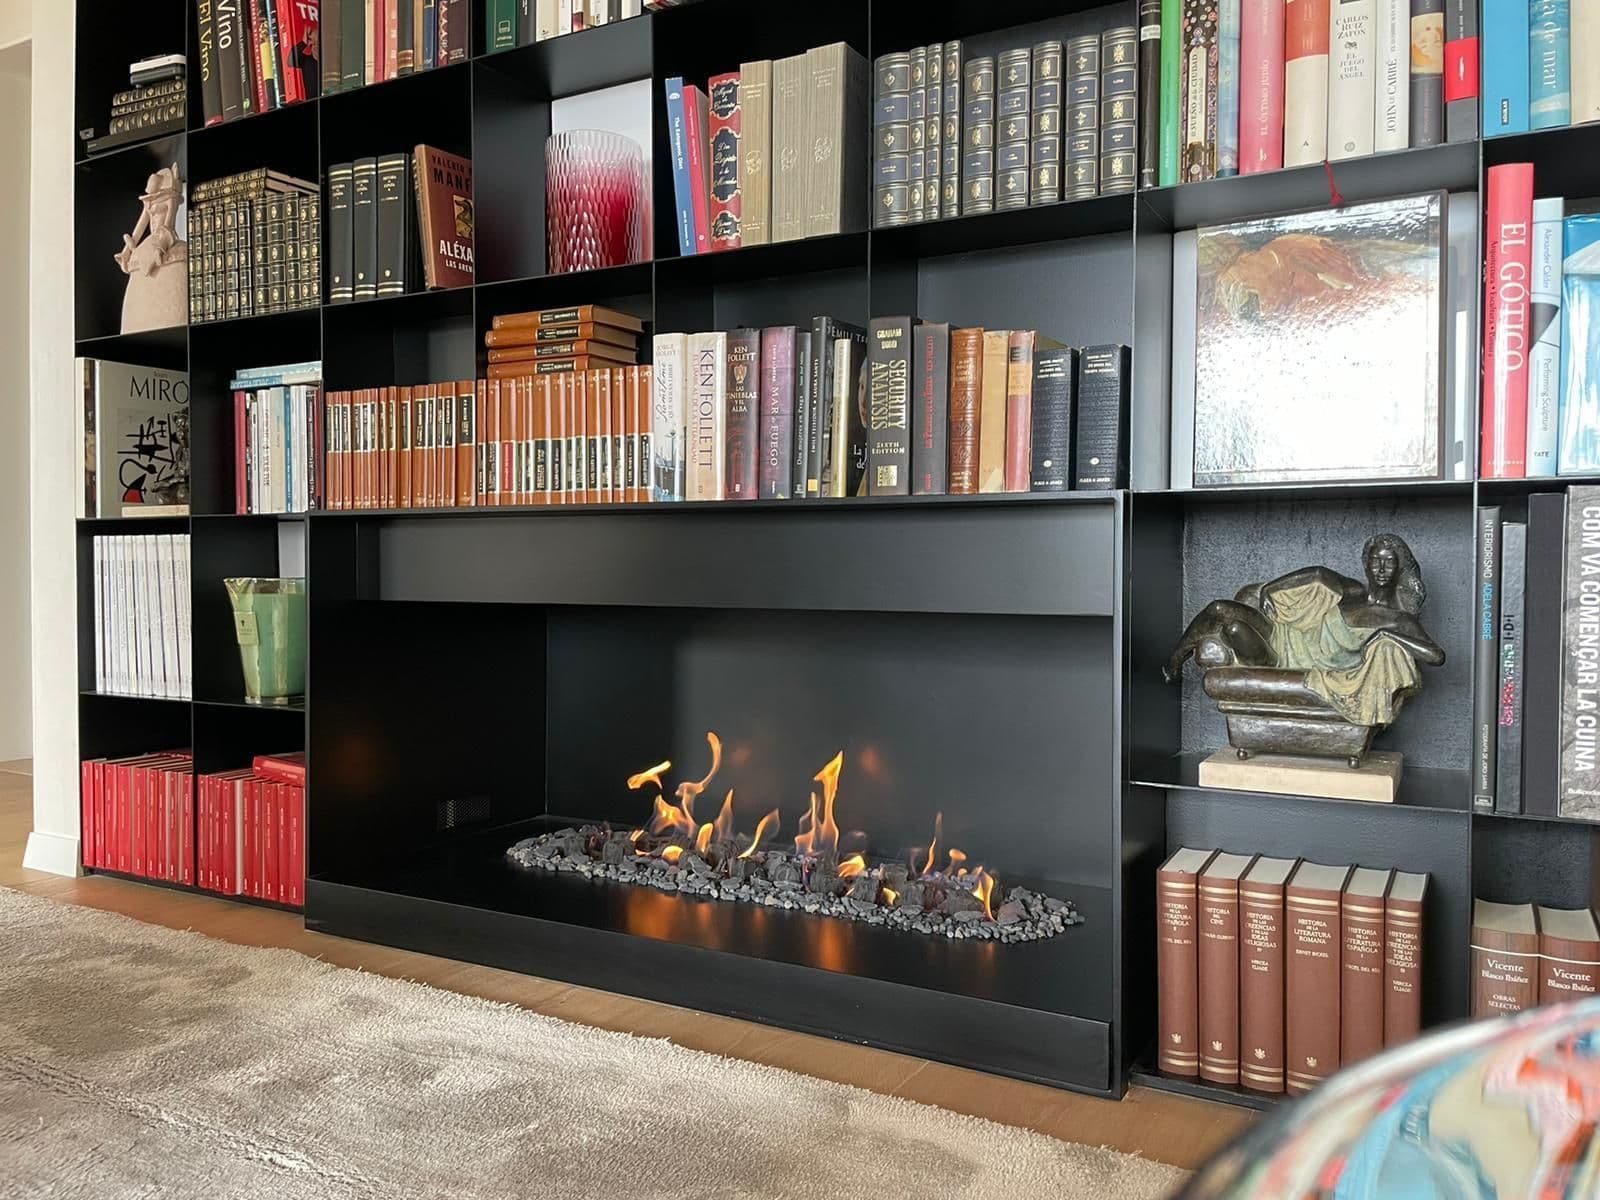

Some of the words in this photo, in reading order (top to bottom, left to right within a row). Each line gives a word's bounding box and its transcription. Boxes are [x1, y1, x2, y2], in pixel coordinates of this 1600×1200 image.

[217, 0, 236, 49] Vino
[1335, 15, 1369, 26] CARLOS
[1341, 23, 1364, 32] RUIZ
[1543, 22, 1561, 44] de
[200, 26, 213, 82] Vino
[1339, 58, 1365, 68] JUEGO
[1190, 54, 1199, 87] CIUDAD
[1543, 49, 1557, 89] mar
[1386, 103, 1397, 133] JOHN
[1500, 222, 1526, 254] EL
[1542, 228, 1552, 264] Alexander
[1542, 264, 1552, 289] Calder
[1499, 262, 1529, 371] GÓTICO
[877, 328, 902, 339] GRAHAM
[727, 352, 757, 362] FOLLETT
[734, 345, 748, 354] KEN
[700, 350, 714, 386] KEN
[1540, 358, 1552, 398] Performing
[771, 385, 780, 416] MAR
[871, 361, 889, 431] ANALYSIS
[888, 359, 906, 430] SECURITY
[732, 404, 748, 413] ALBA
[1540, 398, 1551, 432] Sculpture
[699, 394, 713, 470] FOLLETT
[769, 425, 779, 466] FUEGO
[872, 447, 905, 455] EDITION
[1581, 506, 1600, 548] COM
[1483, 519, 1494, 578] INTERIORISMO
[1580, 553, 1600, 576] VA
[1482, 582, 1493, 610] ADELA
[1481, 610, 1493, 640] CABRÉ
[1572, 580, 1600, 684] COMENÇAR
[1576, 688, 1597, 711] LA
[1575, 715, 1597, 772] CUINA
[1294, 928, 1331, 938] LITERATURA
[1297, 918, 1327, 927] HISTORIA
[1348, 926, 1377, 935] HISTORIA
[1251, 933, 1269, 941] IDEAS
[1299, 936, 1327, 945] ROMANA
[1393, 953, 1413, 961] IDEAS
[1486, 958, 1524, 973] Vicente
[1481, 969, 1504, 981] Blasco
[1505, 973, 1529, 984] Ibáñez
[1547, 979, 1571, 990] Blasco
[1572, 983, 1596, 992] Ibáñez
[1553, 967, 1591, 982] Vicente
[1488, 1000, 1521, 1010] SELECTAS
[1492, 993, 1516, 1003] OBRAS
